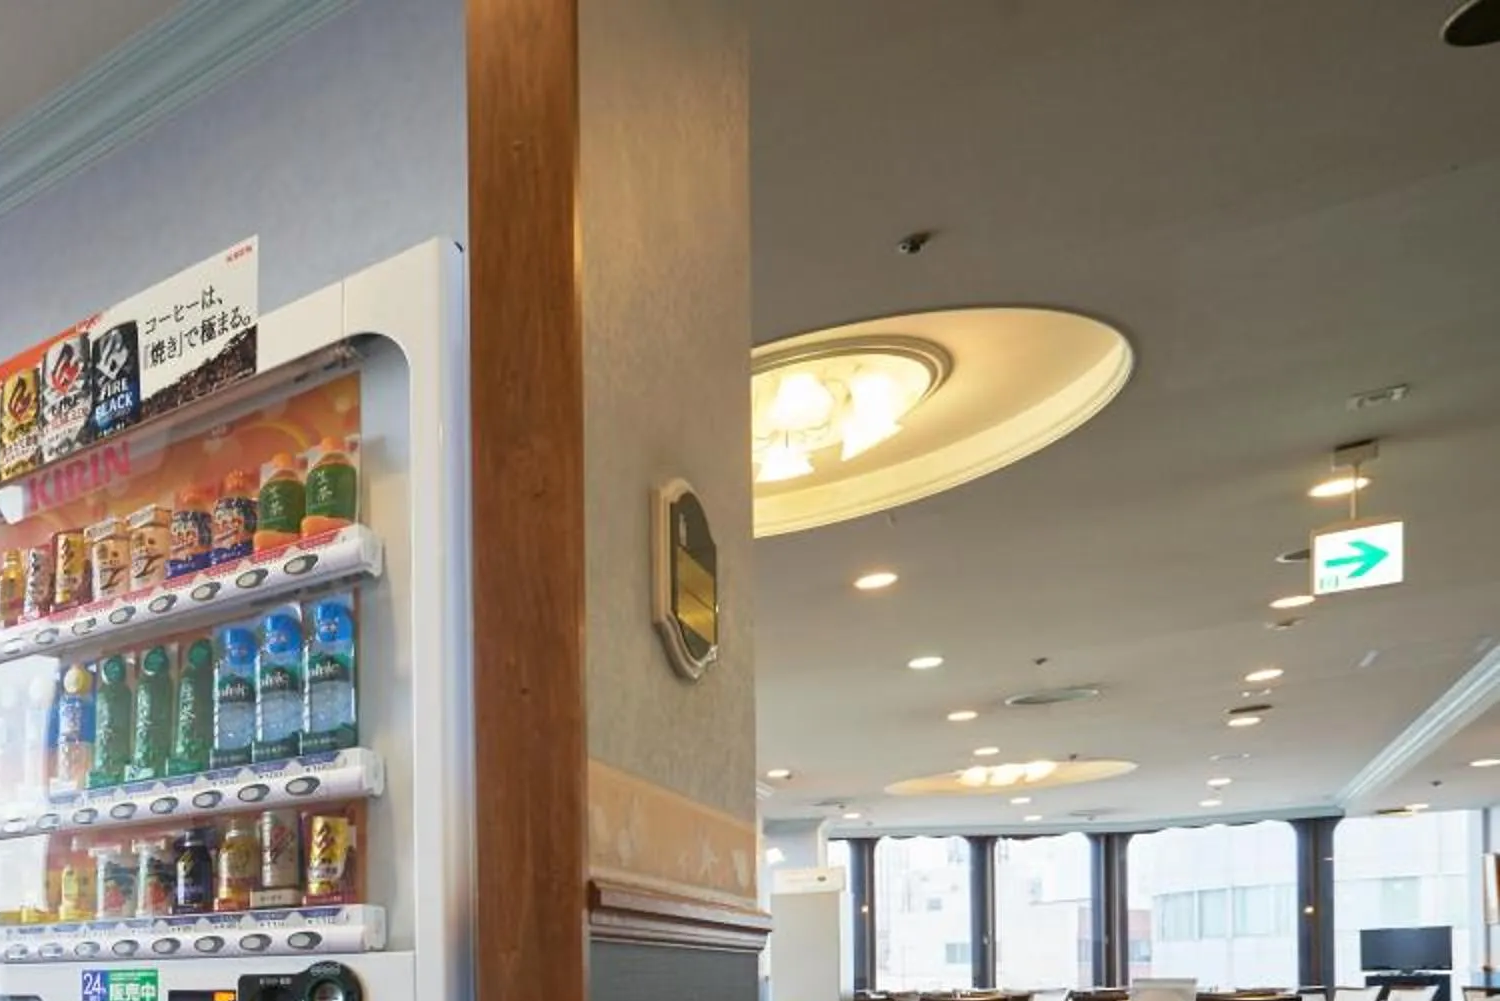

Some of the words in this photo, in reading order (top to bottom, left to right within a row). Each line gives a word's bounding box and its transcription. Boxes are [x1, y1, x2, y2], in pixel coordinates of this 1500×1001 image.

[144, 285, 223, 335] コーヒーは、
[27, 440, 132, 512] KIRIN
